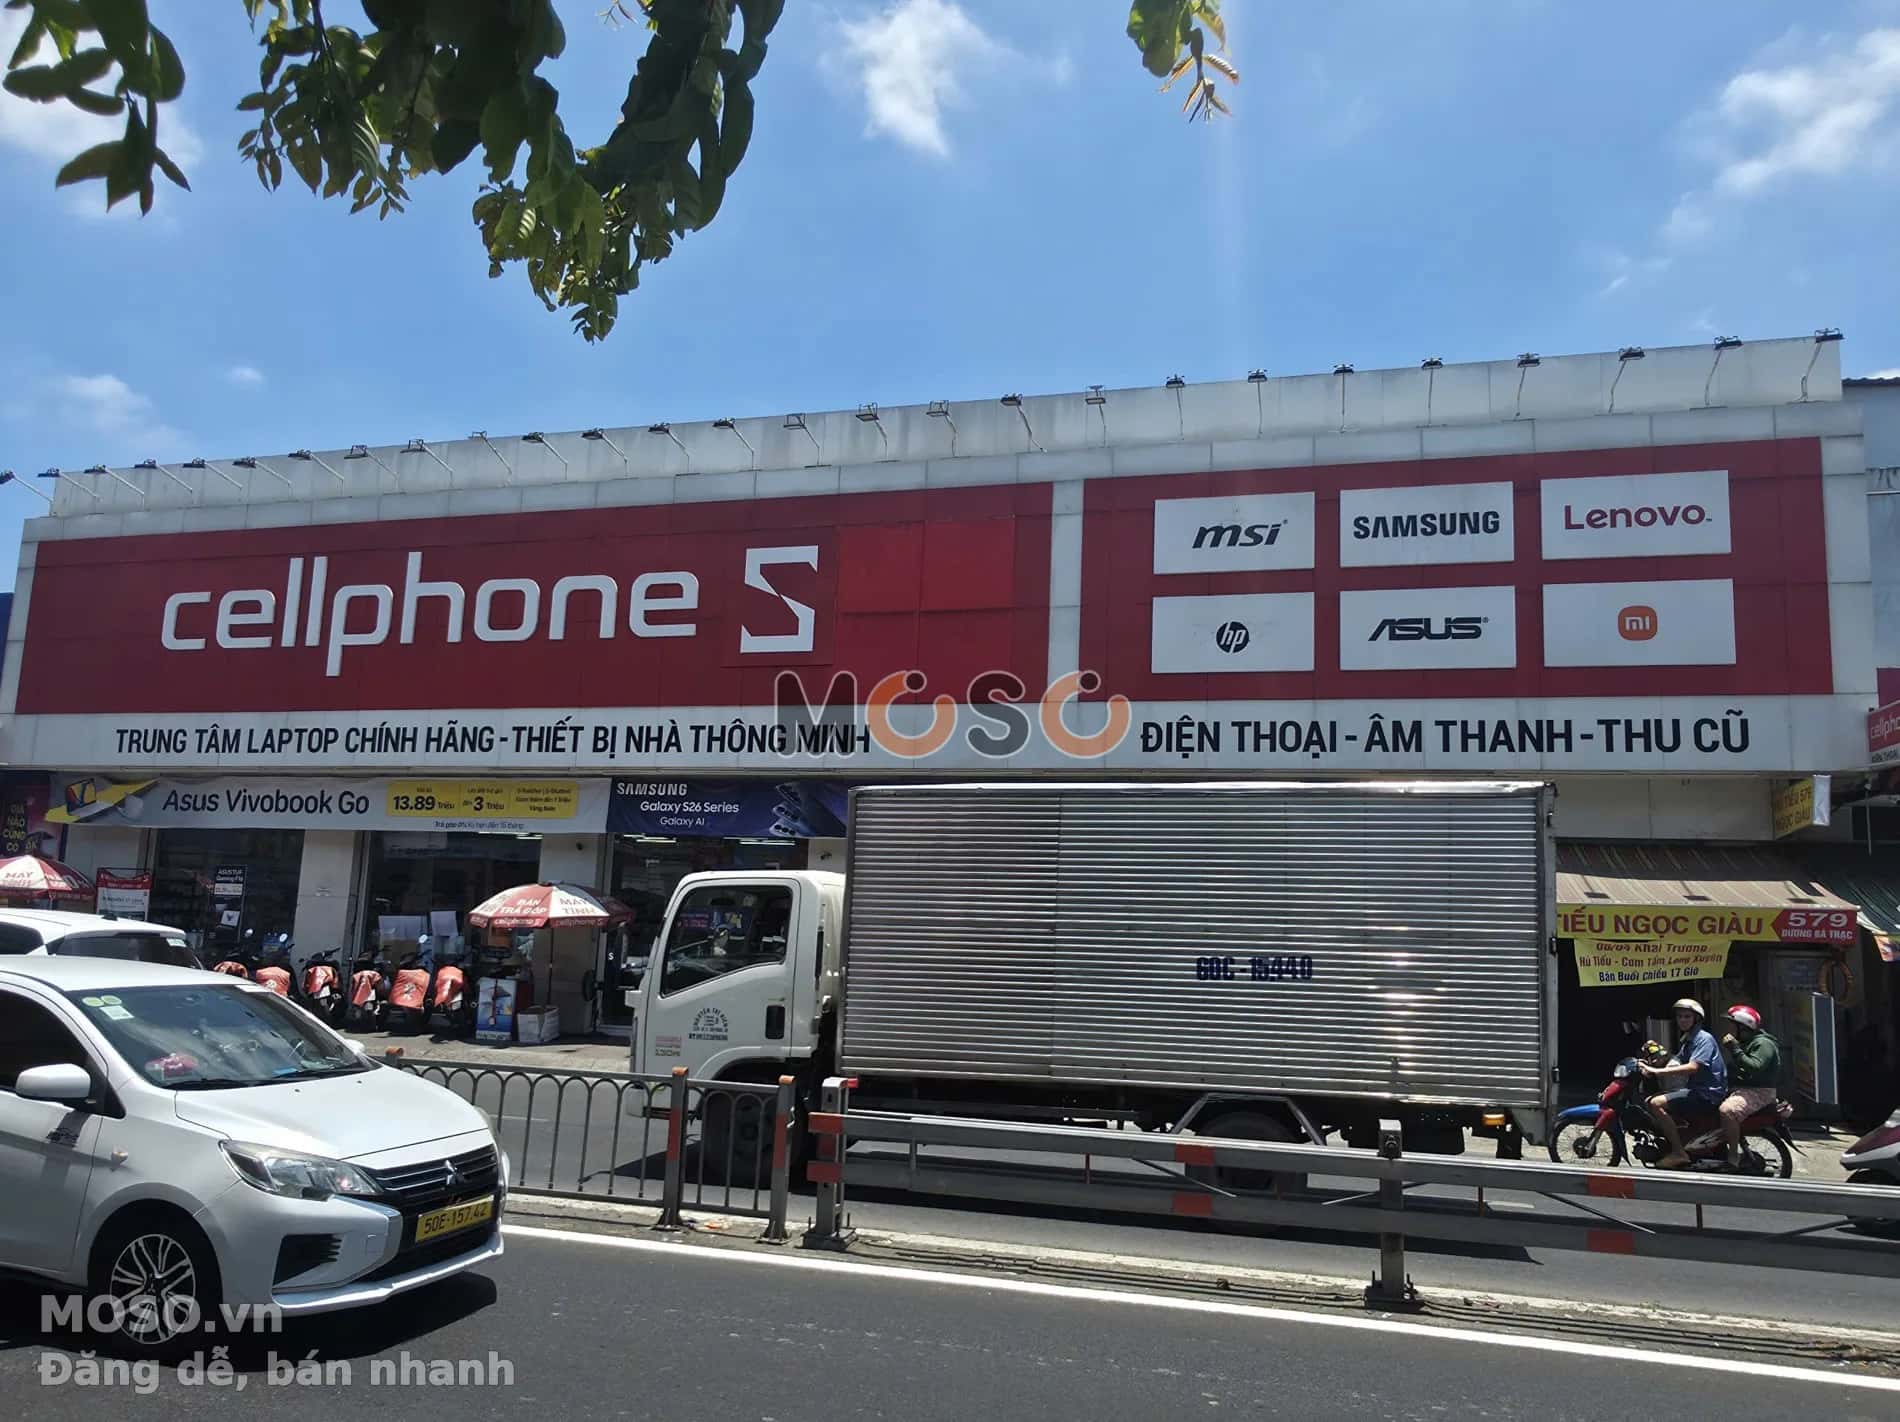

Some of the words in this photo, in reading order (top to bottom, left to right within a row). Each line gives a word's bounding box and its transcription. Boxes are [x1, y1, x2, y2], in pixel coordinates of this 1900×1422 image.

[1353, 511, 1500, 539] SAMSUNG
[1564, 504, 1705, 530] Lenovo
[1192, 522, 1283, 549] msi
[1218, 621, 1248, 653] hp
[1367, 616, 1484, 642] ASUS
[116, 728, 188, 754] TRUNG
[195, 722, 242, 754] TÂM
[247, 727, 339, 754] LAPTOP
[345, 721, 418, 753] CHÍNH
[425, 720, 495, 753] HÃNG
[512, 716, 585, 753] THIẾT
[592, 725, 618, 759] BỊ
[625, 719, 683, 753] NHÀ
[690, 718, 787, 753] THÔNG
[797, 724, 871, 753] MINH
[1140, 714, 1220, 759] ĐIỆN
[1231, 720, 1337, 759] THOẠI
[1364, 713, 1422, 753] ÂM
[1435, 719, 1572, 753] THANH
[1597, 719, 1682, 753] THU
[1693, 708, 1750, 753] CŨ
[162, 790, 219, 812] Asus
[226, 789, 333, 814] Vivobook
[338, 791, 369, 814] Go
[617, 782, 688, 796] SAMSUNG
[393, 796, 436, 811] 13.89
[474, 796, 485, 811] 3
[640, 801, 681, 814] Galaxy
[683, 802, 701, 813] S26
[704, 803, 740, 813] Series
[660, 816, 694, 826] Galaxy
[1557, 906, 1605, 933] IẾU
[1614, 915, 1689, 939] NGỌC
[1698, 912, 1763, 935] GIÀU
[1788, 912, 1848, 928] 579
